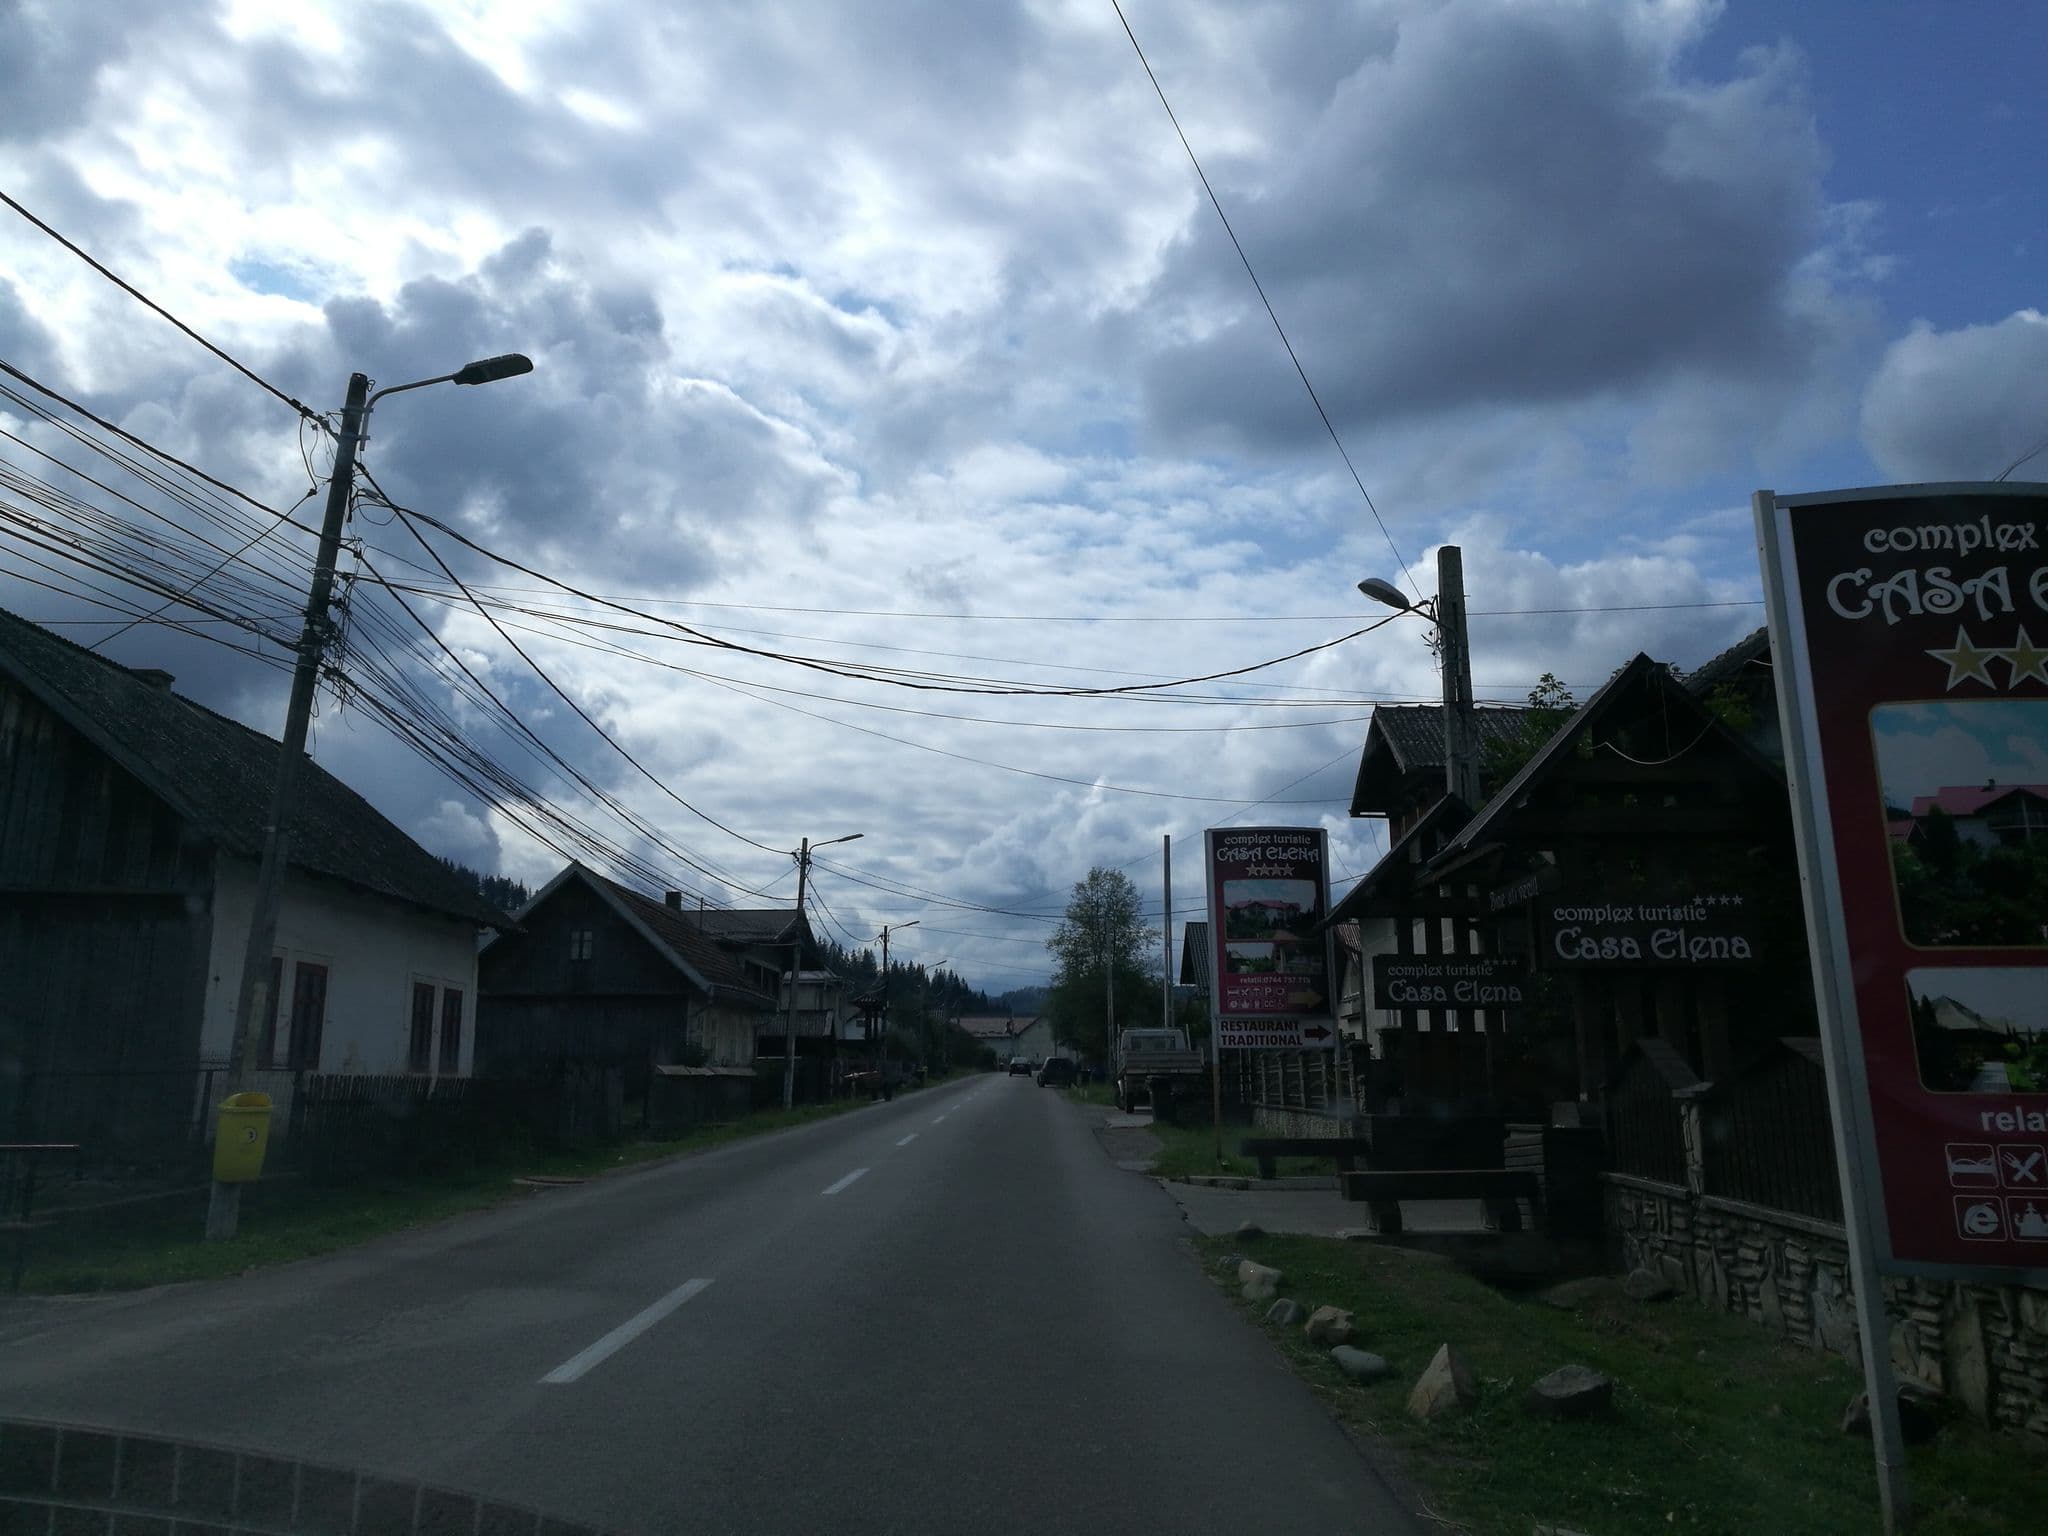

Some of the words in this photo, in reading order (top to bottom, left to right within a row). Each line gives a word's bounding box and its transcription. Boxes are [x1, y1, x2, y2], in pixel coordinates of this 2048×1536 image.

[1864, 514, 2040, 558] complex
[1826, 566, 2016, 626] CASA
[1225, 833, 1271, 846] complex
[1274, 833, 1311, 845] turistic
[1216, 847, 1262, 862] CASA
[1266, 847, 1319, 862] ELENA
[1553, 903, 1634, 925] complex
[1639, 904, 1707, 921] turistic
[1554, 926, 1642, 959] Casa
[1649, 928, 1753, 962] Elena
[1387, 963, 1443, 978] complex
[1446, 963, 1494, 976] turistic
[1388, 979, 1448, 1002] Casa
[1454, 979, 1522, 1003] Elena
[1221, 1020, 1299, 1031] RESTAURANT
[1221, 1034, 1303, 1046] TRADITIONAL
